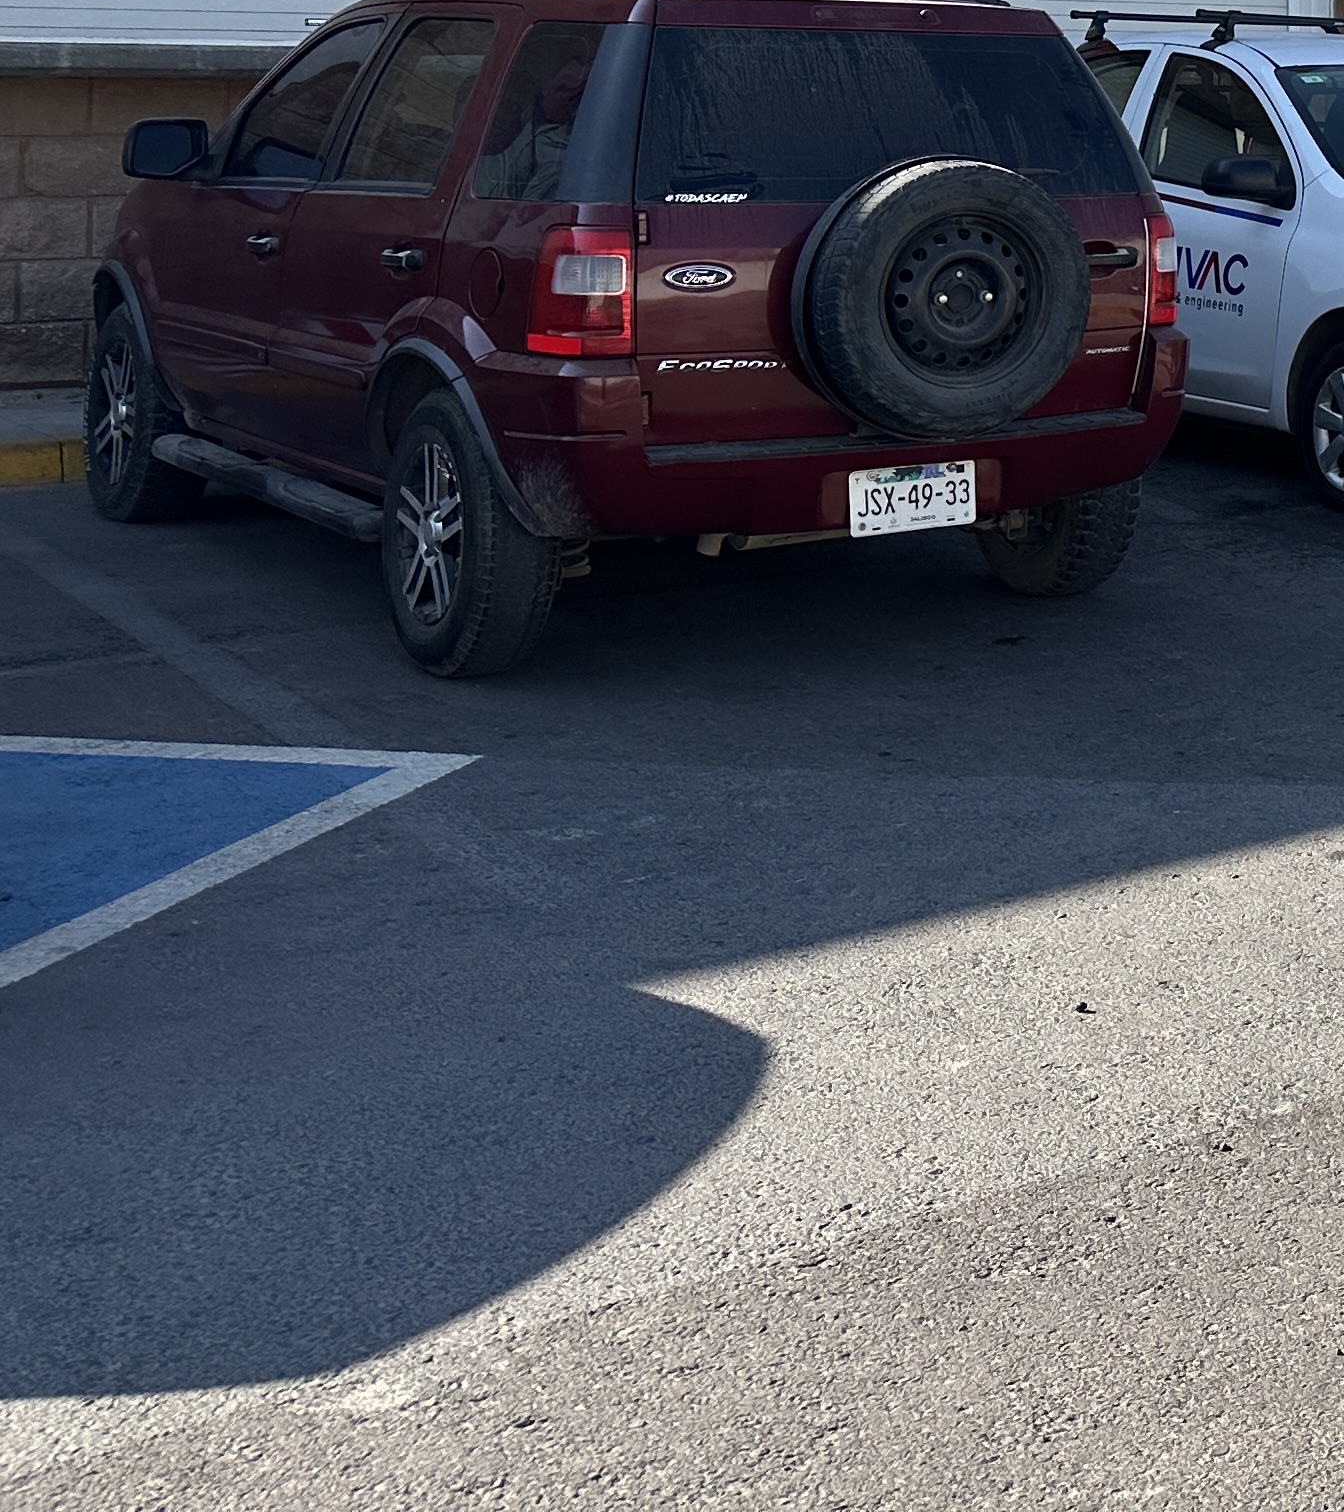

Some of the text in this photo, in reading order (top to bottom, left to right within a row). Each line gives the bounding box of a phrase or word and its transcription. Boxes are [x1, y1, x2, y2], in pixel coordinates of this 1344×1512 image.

[664, 193, 748, 203] #TODASCAEN
[682, 270, 717, 284] Ford
[1185, 295, 1244, 316] engineering
[857, 478, 970, 518] JSX-49-33
